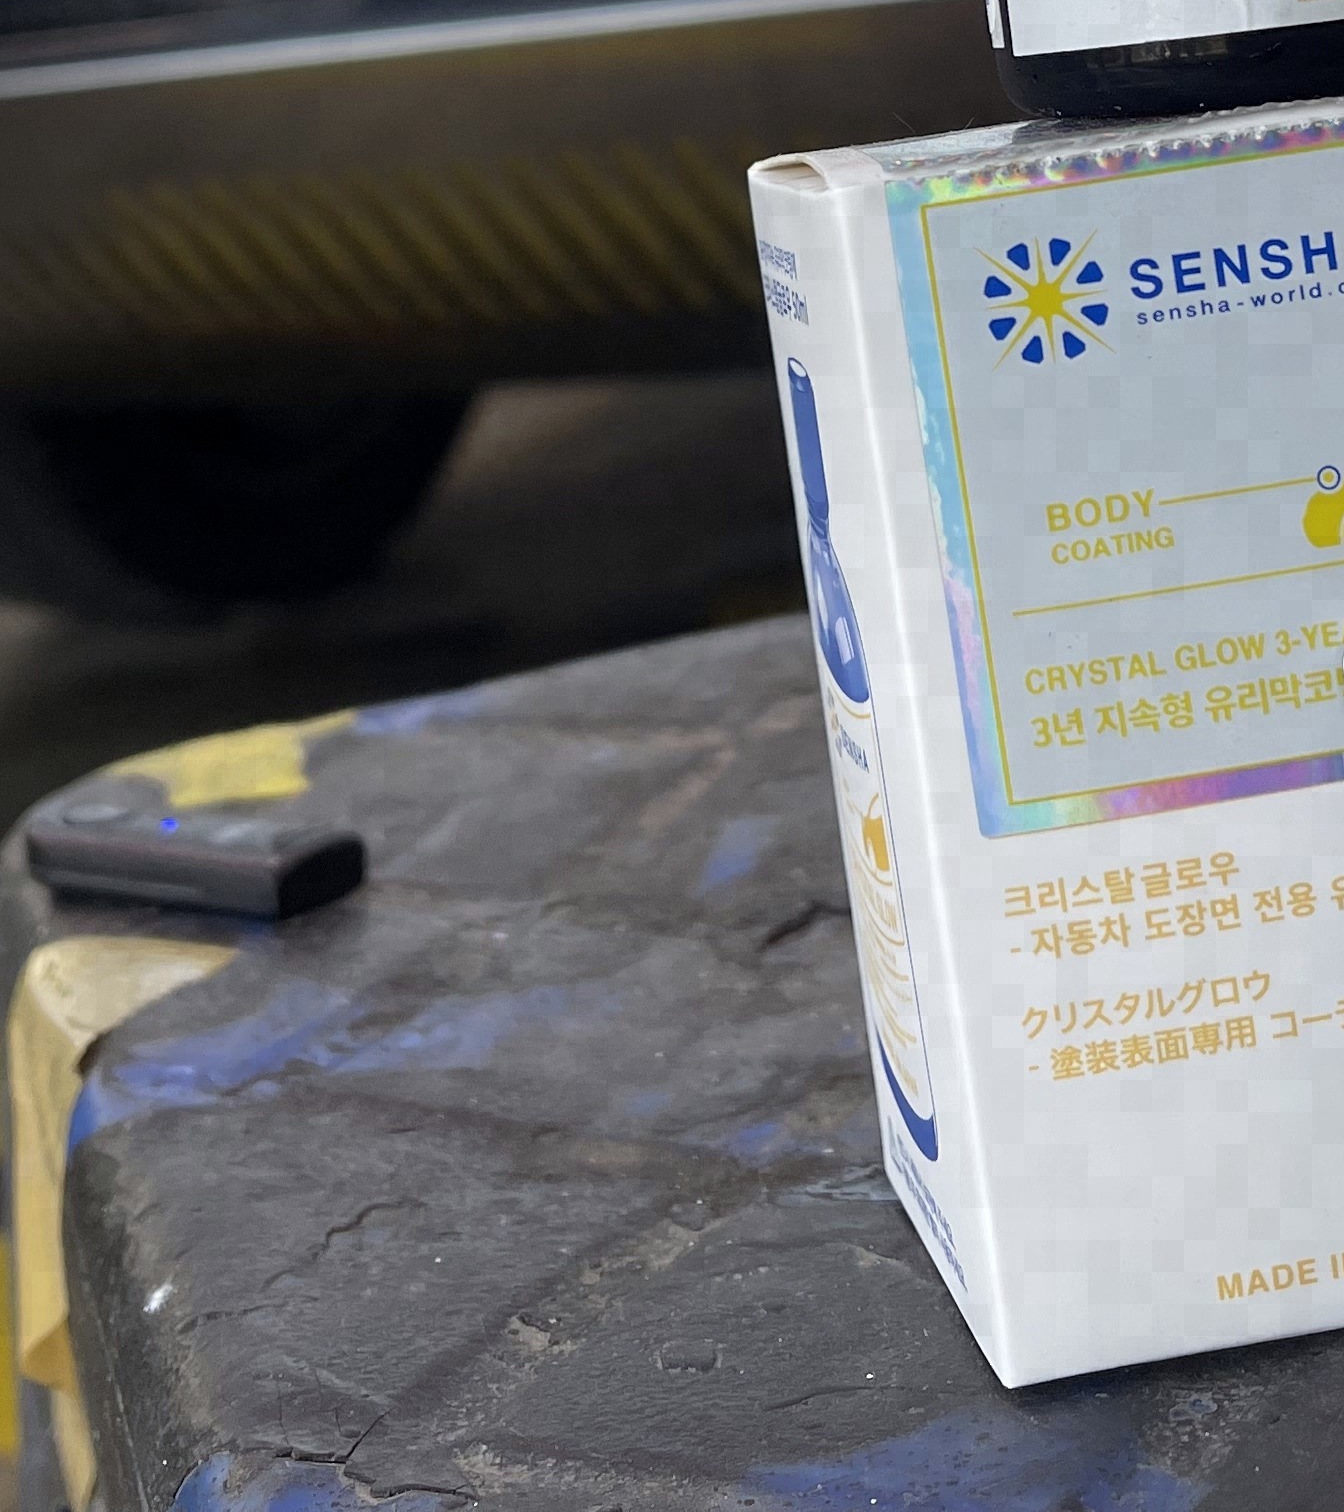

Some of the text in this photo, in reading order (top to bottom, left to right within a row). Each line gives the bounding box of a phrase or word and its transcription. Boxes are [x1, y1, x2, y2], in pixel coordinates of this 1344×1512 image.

[1045, 489, 1155, 533] BODY
[1051, 526, 1175, 566] COATING
[1025, 653, 1165, 696] CRYSTAL
[1175, 630, 1265, 673] GLOW
[1031, 715, 1087, 748] 3년
[1095, 693, 1193, 739] 지속형
[1032, 919, 1131, 961] 자동차
[1146, 895, 1242, 942] 도장면
[1252, 881, 1317, 924] 전용
[1021, 970, 1272, 1041] クリスタルグロウ
[1217, 1258, 1318, 1300] MADE
